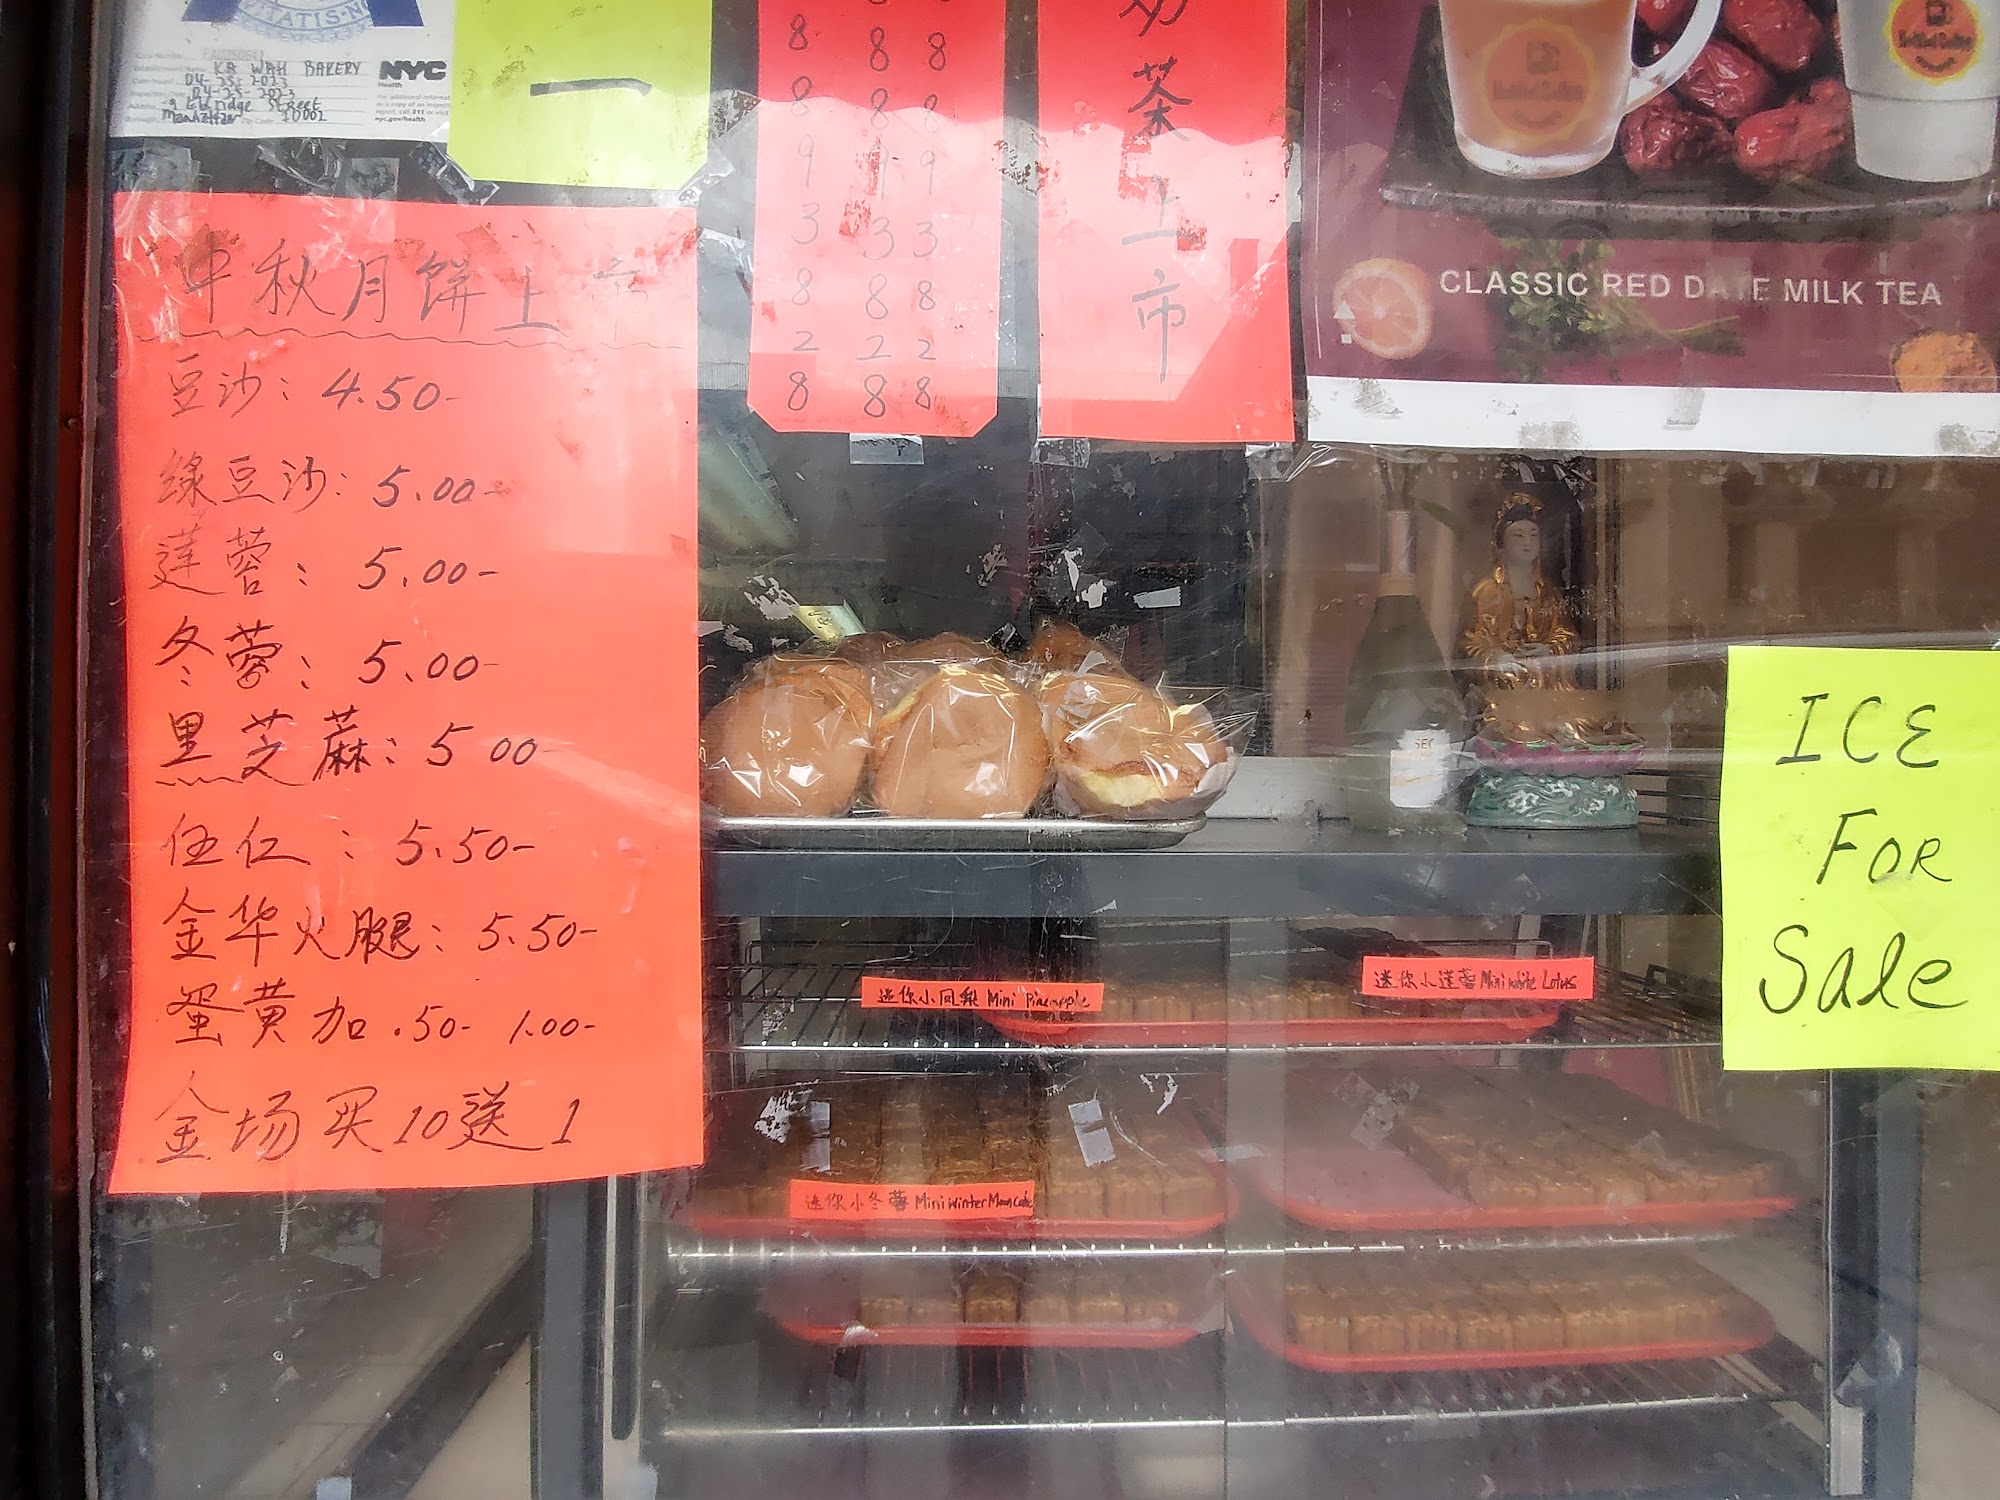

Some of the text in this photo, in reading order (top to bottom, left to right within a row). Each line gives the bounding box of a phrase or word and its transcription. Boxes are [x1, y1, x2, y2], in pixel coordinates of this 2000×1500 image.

[379, 60, 447, 80] NYC
[1440, 270, 1588, 297] CLASSIC
[1602, 274, 1671, 299] RED
[1783, 279, 1864, 305] MILK
[1877, 282, 1942, 306] TEA
[1775, 693, 1939, 768] ICE
[1759, 924, 1968, 1014] Sale
[987, 988, 1015, 1007] Mini
[915, 1192, 944, 1209] Mini
